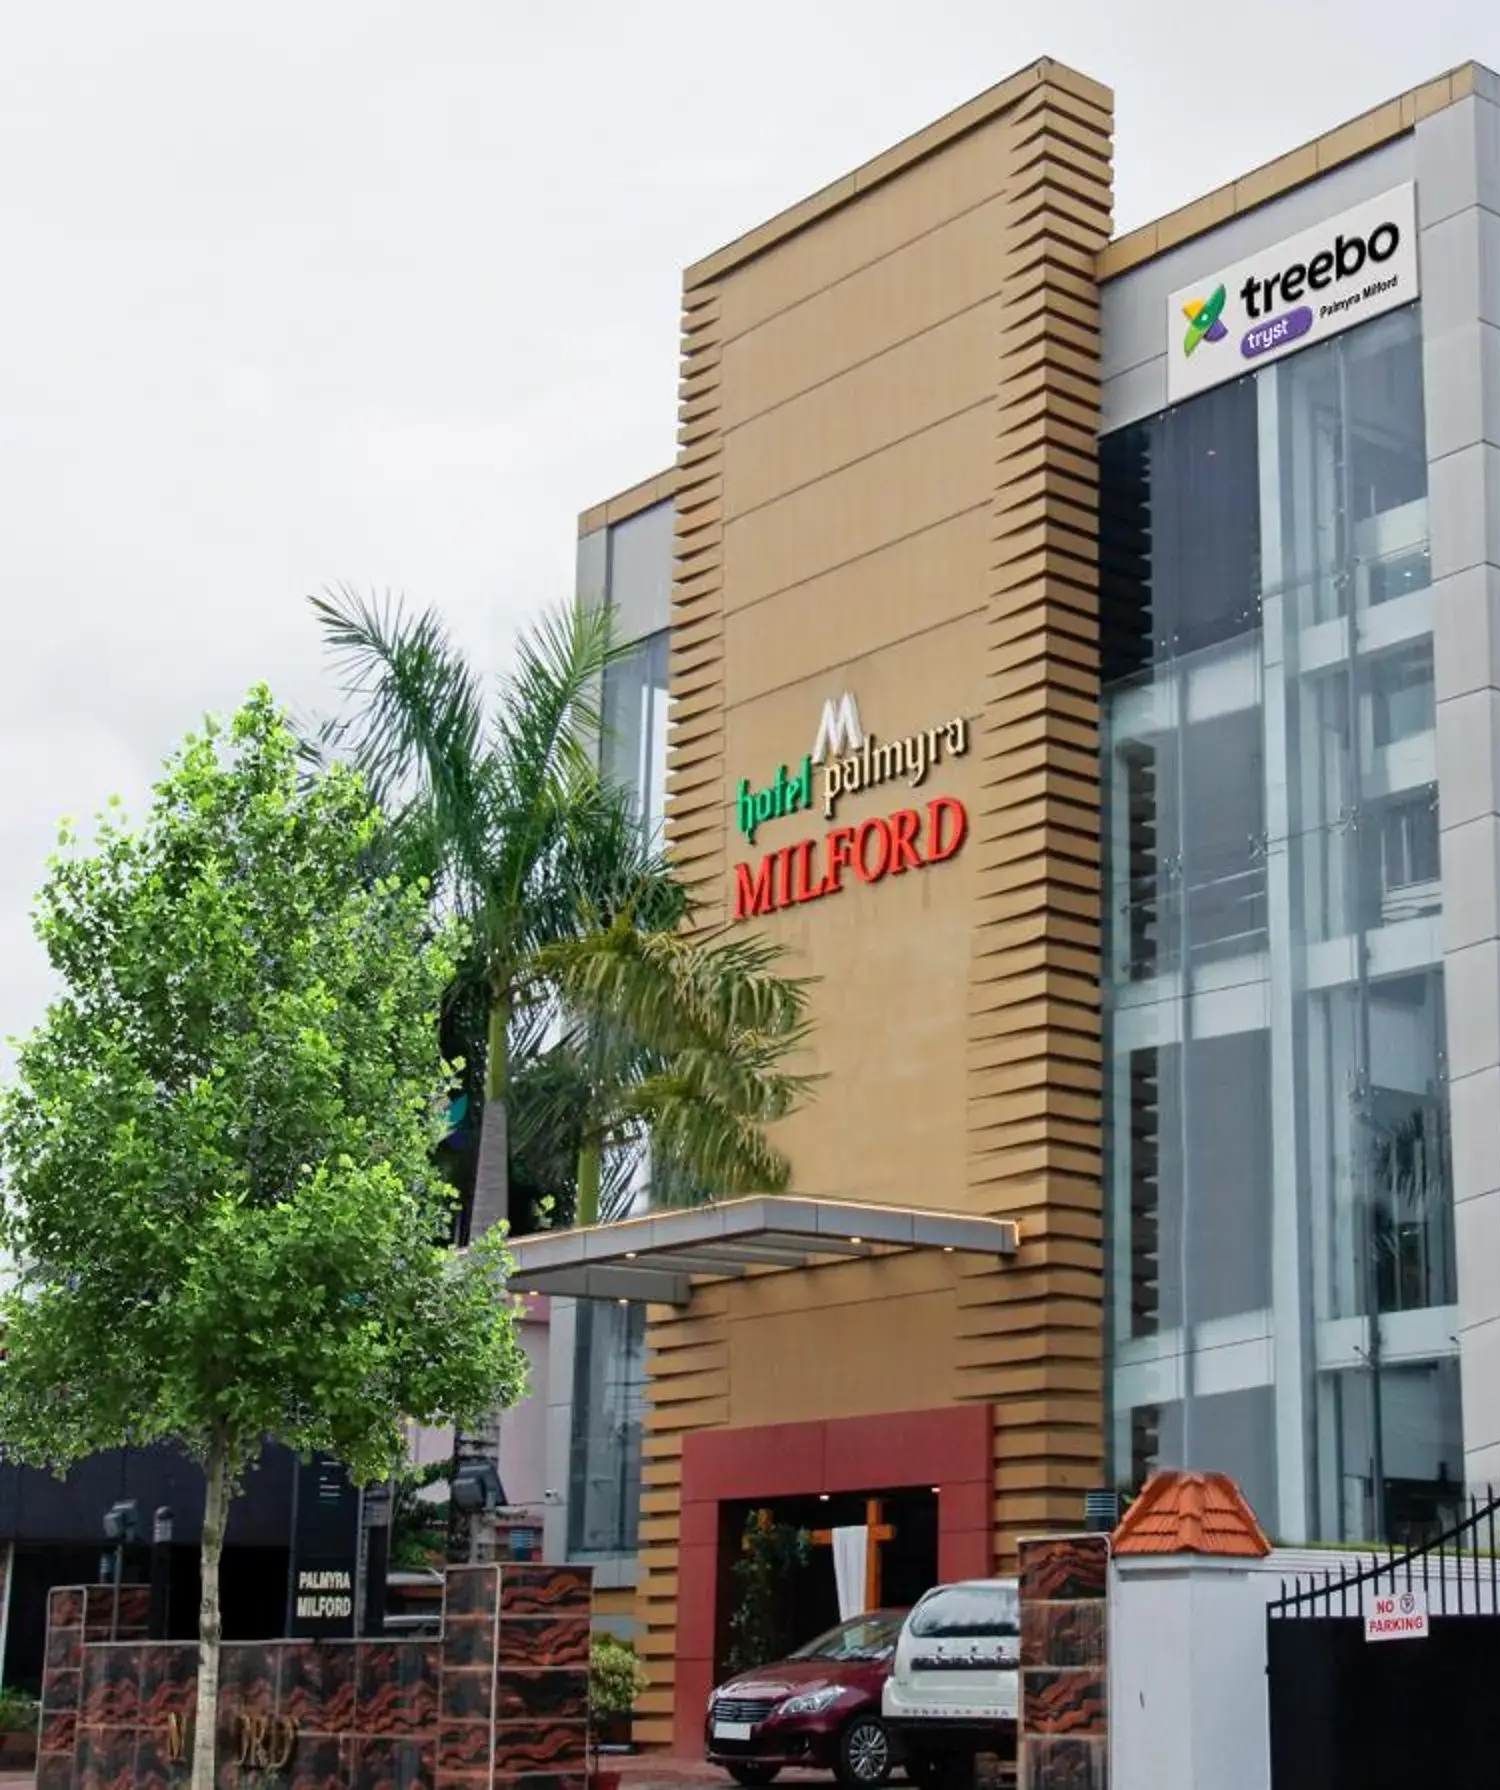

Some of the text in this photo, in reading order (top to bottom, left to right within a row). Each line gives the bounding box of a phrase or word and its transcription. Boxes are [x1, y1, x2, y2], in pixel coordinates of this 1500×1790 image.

[1240, 222, 1400, 318] treebo
[1319, 274, 1398, 319] Palmyra Milford
[1247, 319, 1289, 350] tryst
[736, 716, 969, 844] hotel palmyra
[734, 793, 969, 920] MILFORD
[299, 1571, 351, 1589] PALMYRA
[297, 1596, 351, 1616] MILFORD
[1376, 1600, 1394, 1614] NO
[1369, 1616, 1424, 1633] PARKING
